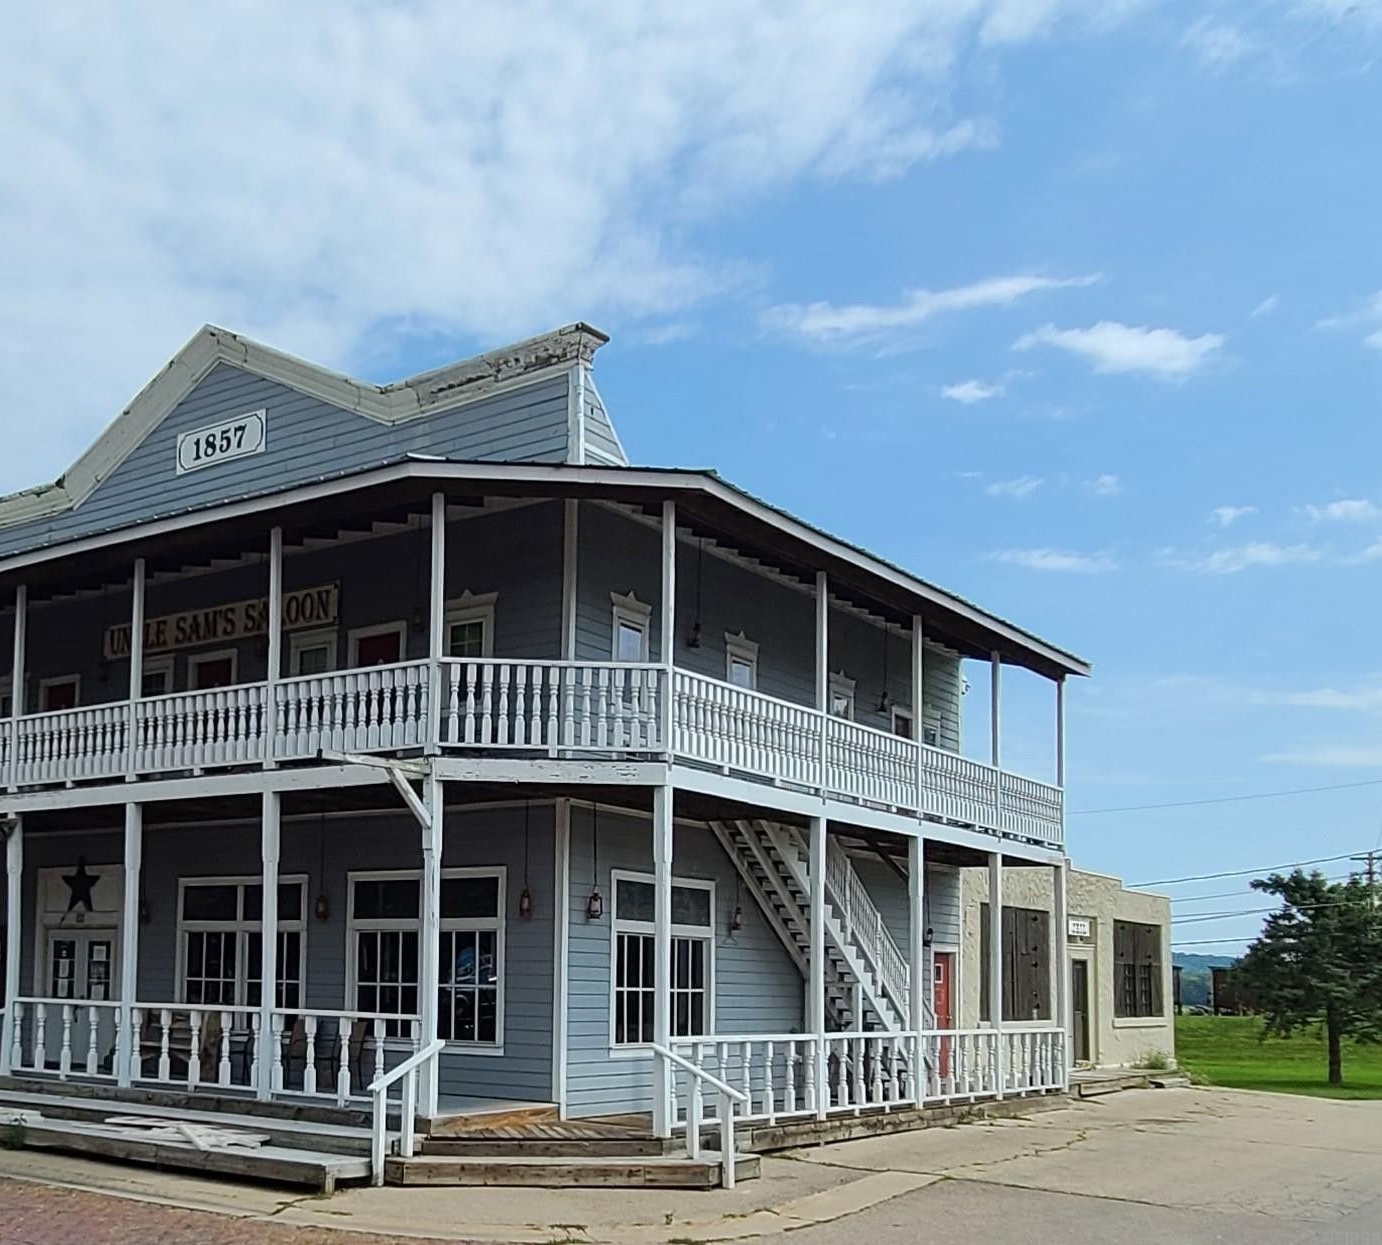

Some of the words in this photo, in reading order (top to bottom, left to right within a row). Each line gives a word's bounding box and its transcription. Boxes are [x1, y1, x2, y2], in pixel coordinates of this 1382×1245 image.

[193, 423, 247, 461] 1857
[110, 619, 168, 655] UNLE
[174, 607, 236, 644] SAM'S
[243, 589, 332, 633] SAOON
